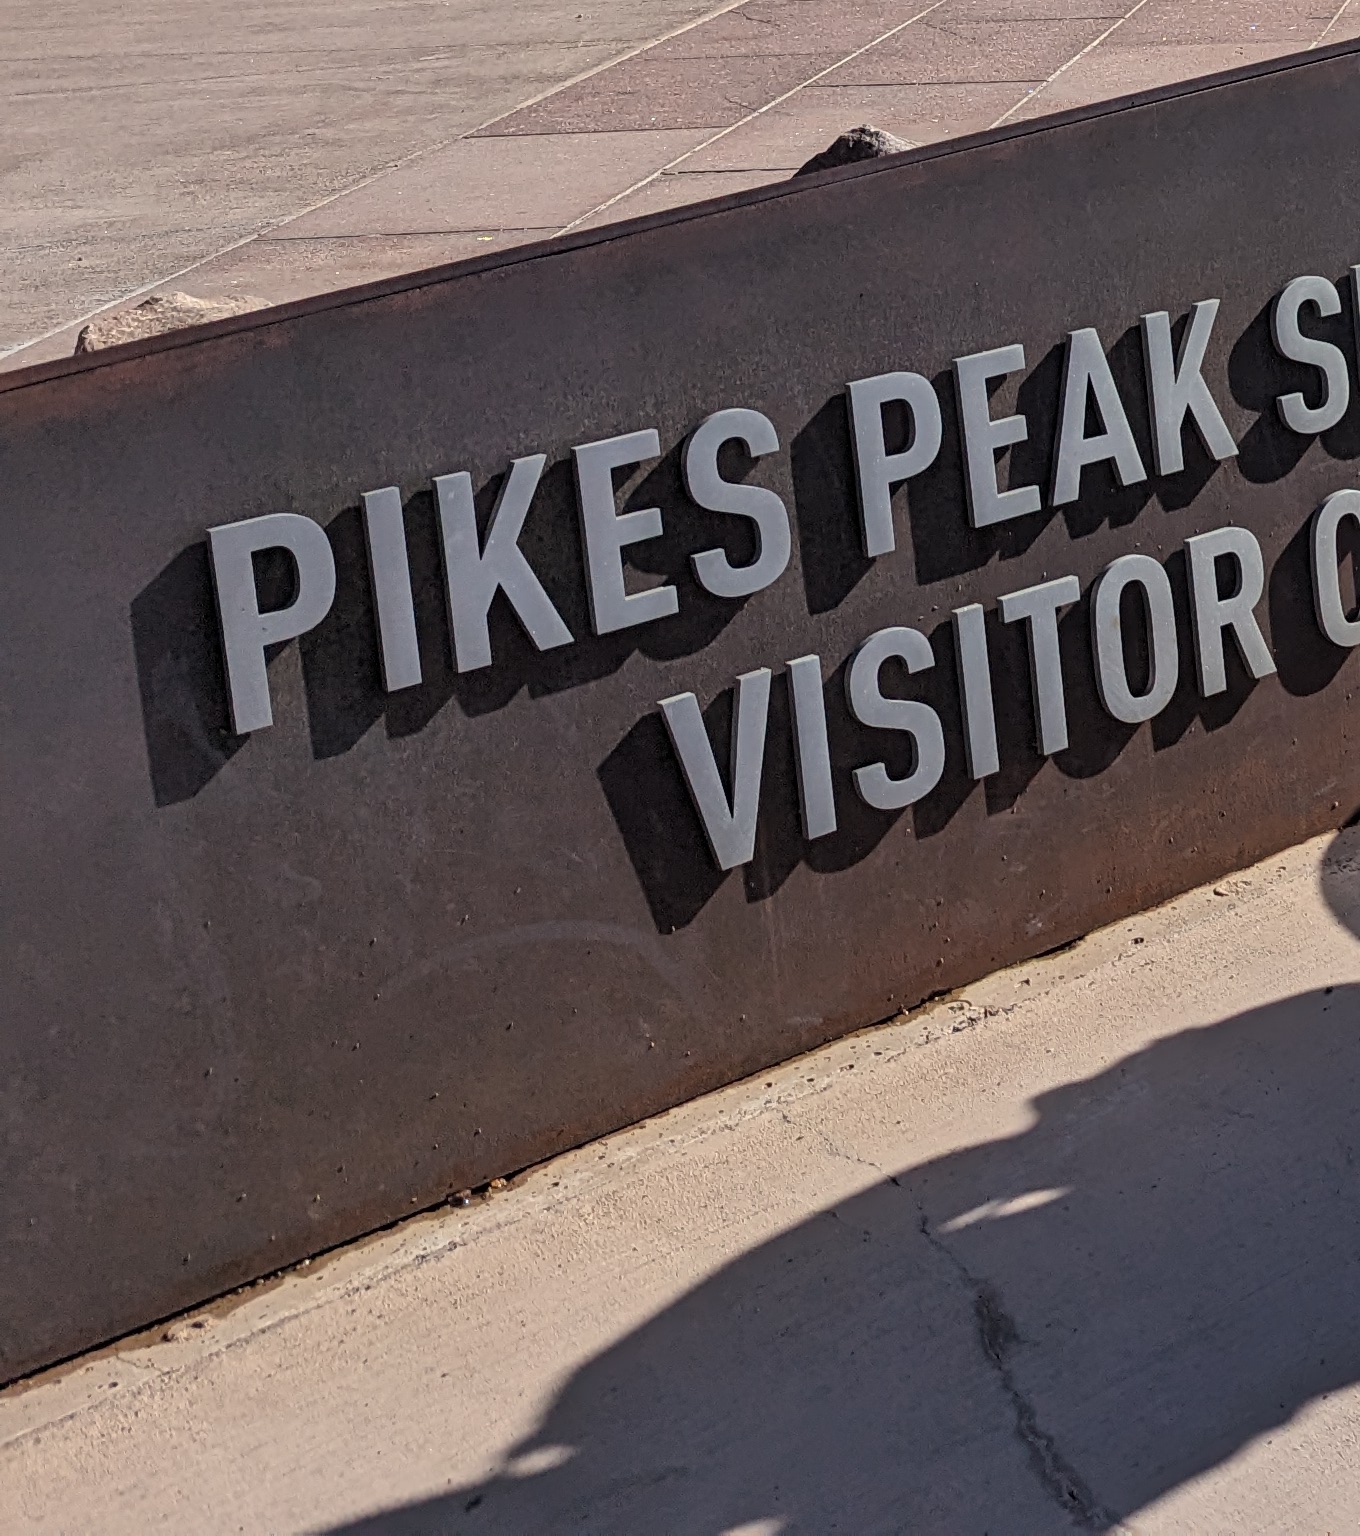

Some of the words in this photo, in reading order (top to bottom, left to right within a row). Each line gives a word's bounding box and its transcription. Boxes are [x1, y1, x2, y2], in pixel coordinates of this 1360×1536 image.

[208, 407, 791, 736] PIKES
[845, 297, 1239, 557] PEAK
[660, 524, 1275, 871] VISITOR
